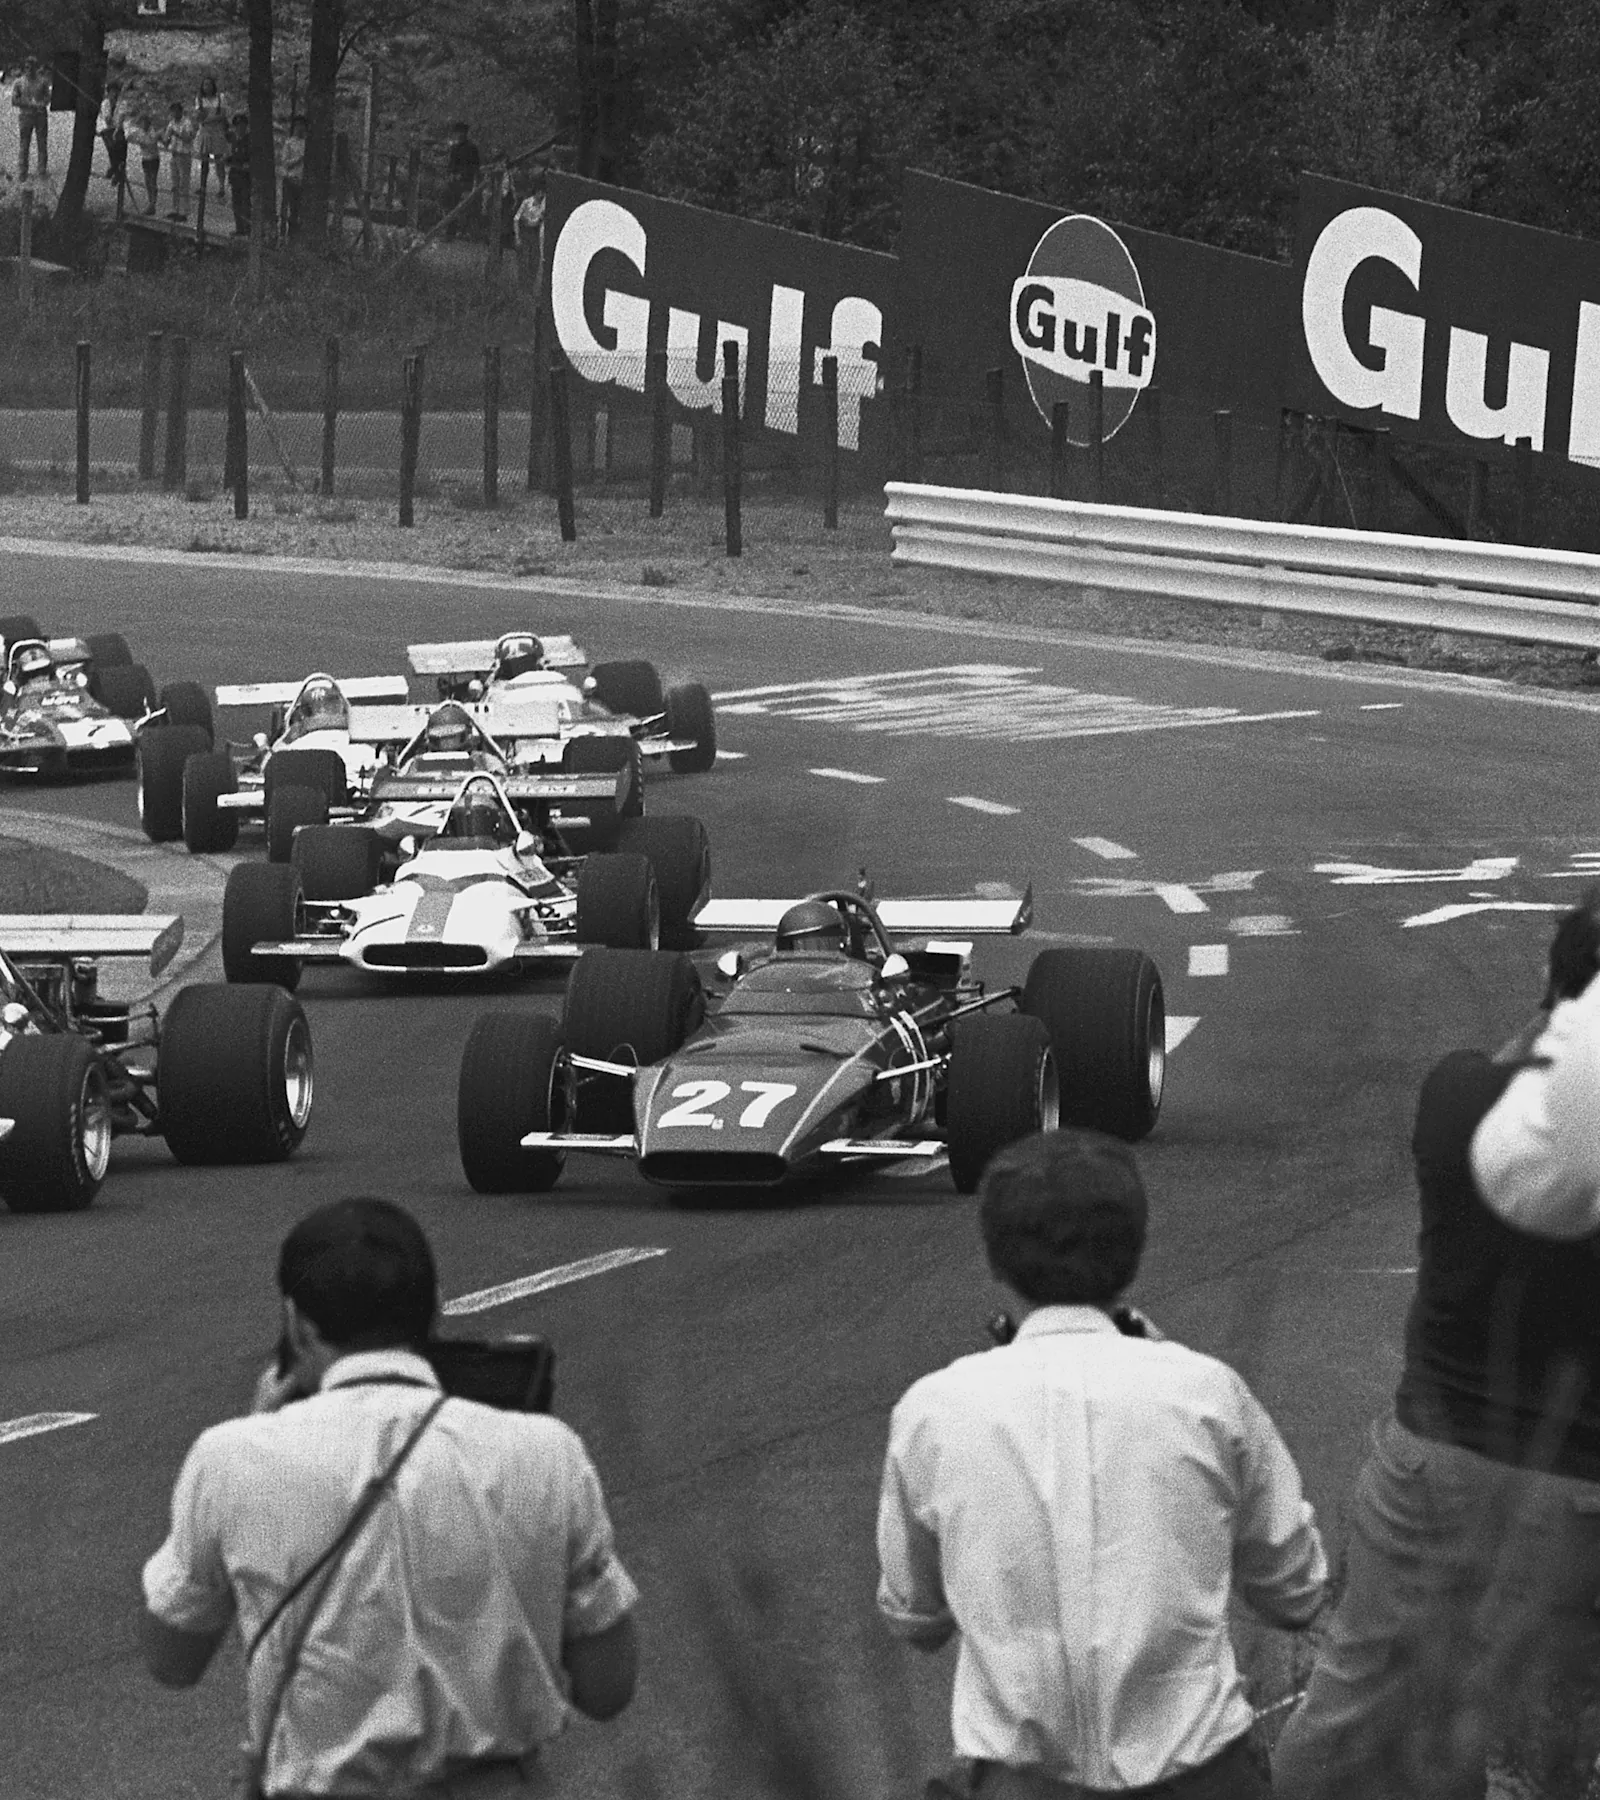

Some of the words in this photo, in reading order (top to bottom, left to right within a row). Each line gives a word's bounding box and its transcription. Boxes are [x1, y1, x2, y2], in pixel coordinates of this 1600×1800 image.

[551, 199, 885, 452] Gulf
[1016, 283, 1153, 377] Gulf
[656, 1080, 798, 1129] 27
